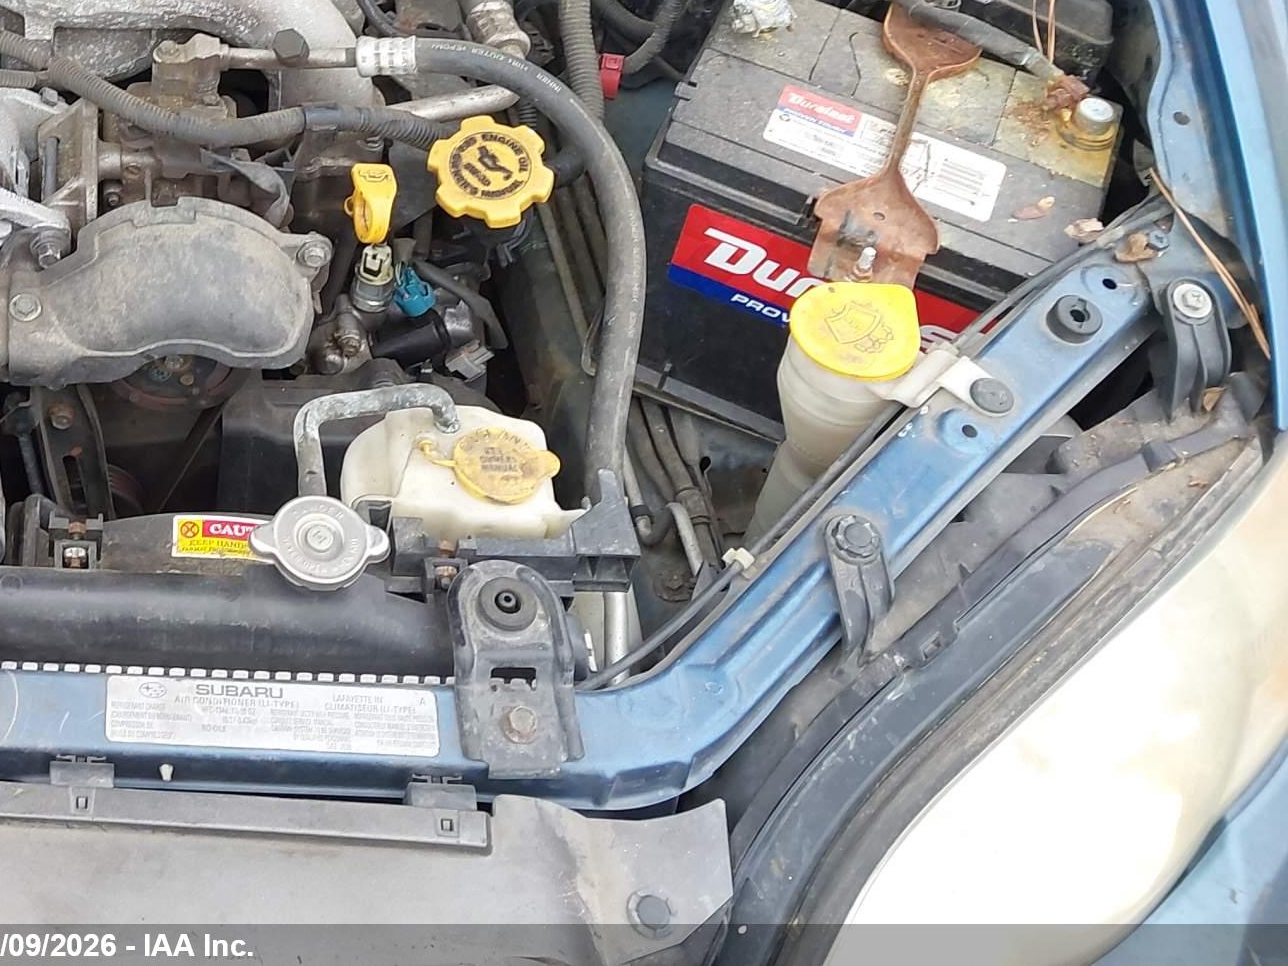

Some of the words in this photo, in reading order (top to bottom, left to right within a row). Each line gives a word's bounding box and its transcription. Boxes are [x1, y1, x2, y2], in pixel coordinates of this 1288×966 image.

[481, 134, 524, 156] ENGINE
[518, 156, 529, 174] OIL
[731, 293, 791, 323] PROV
[193, 696, 256, 707] CONDITIONER
[195, 684, 284, 699] SUBARU
